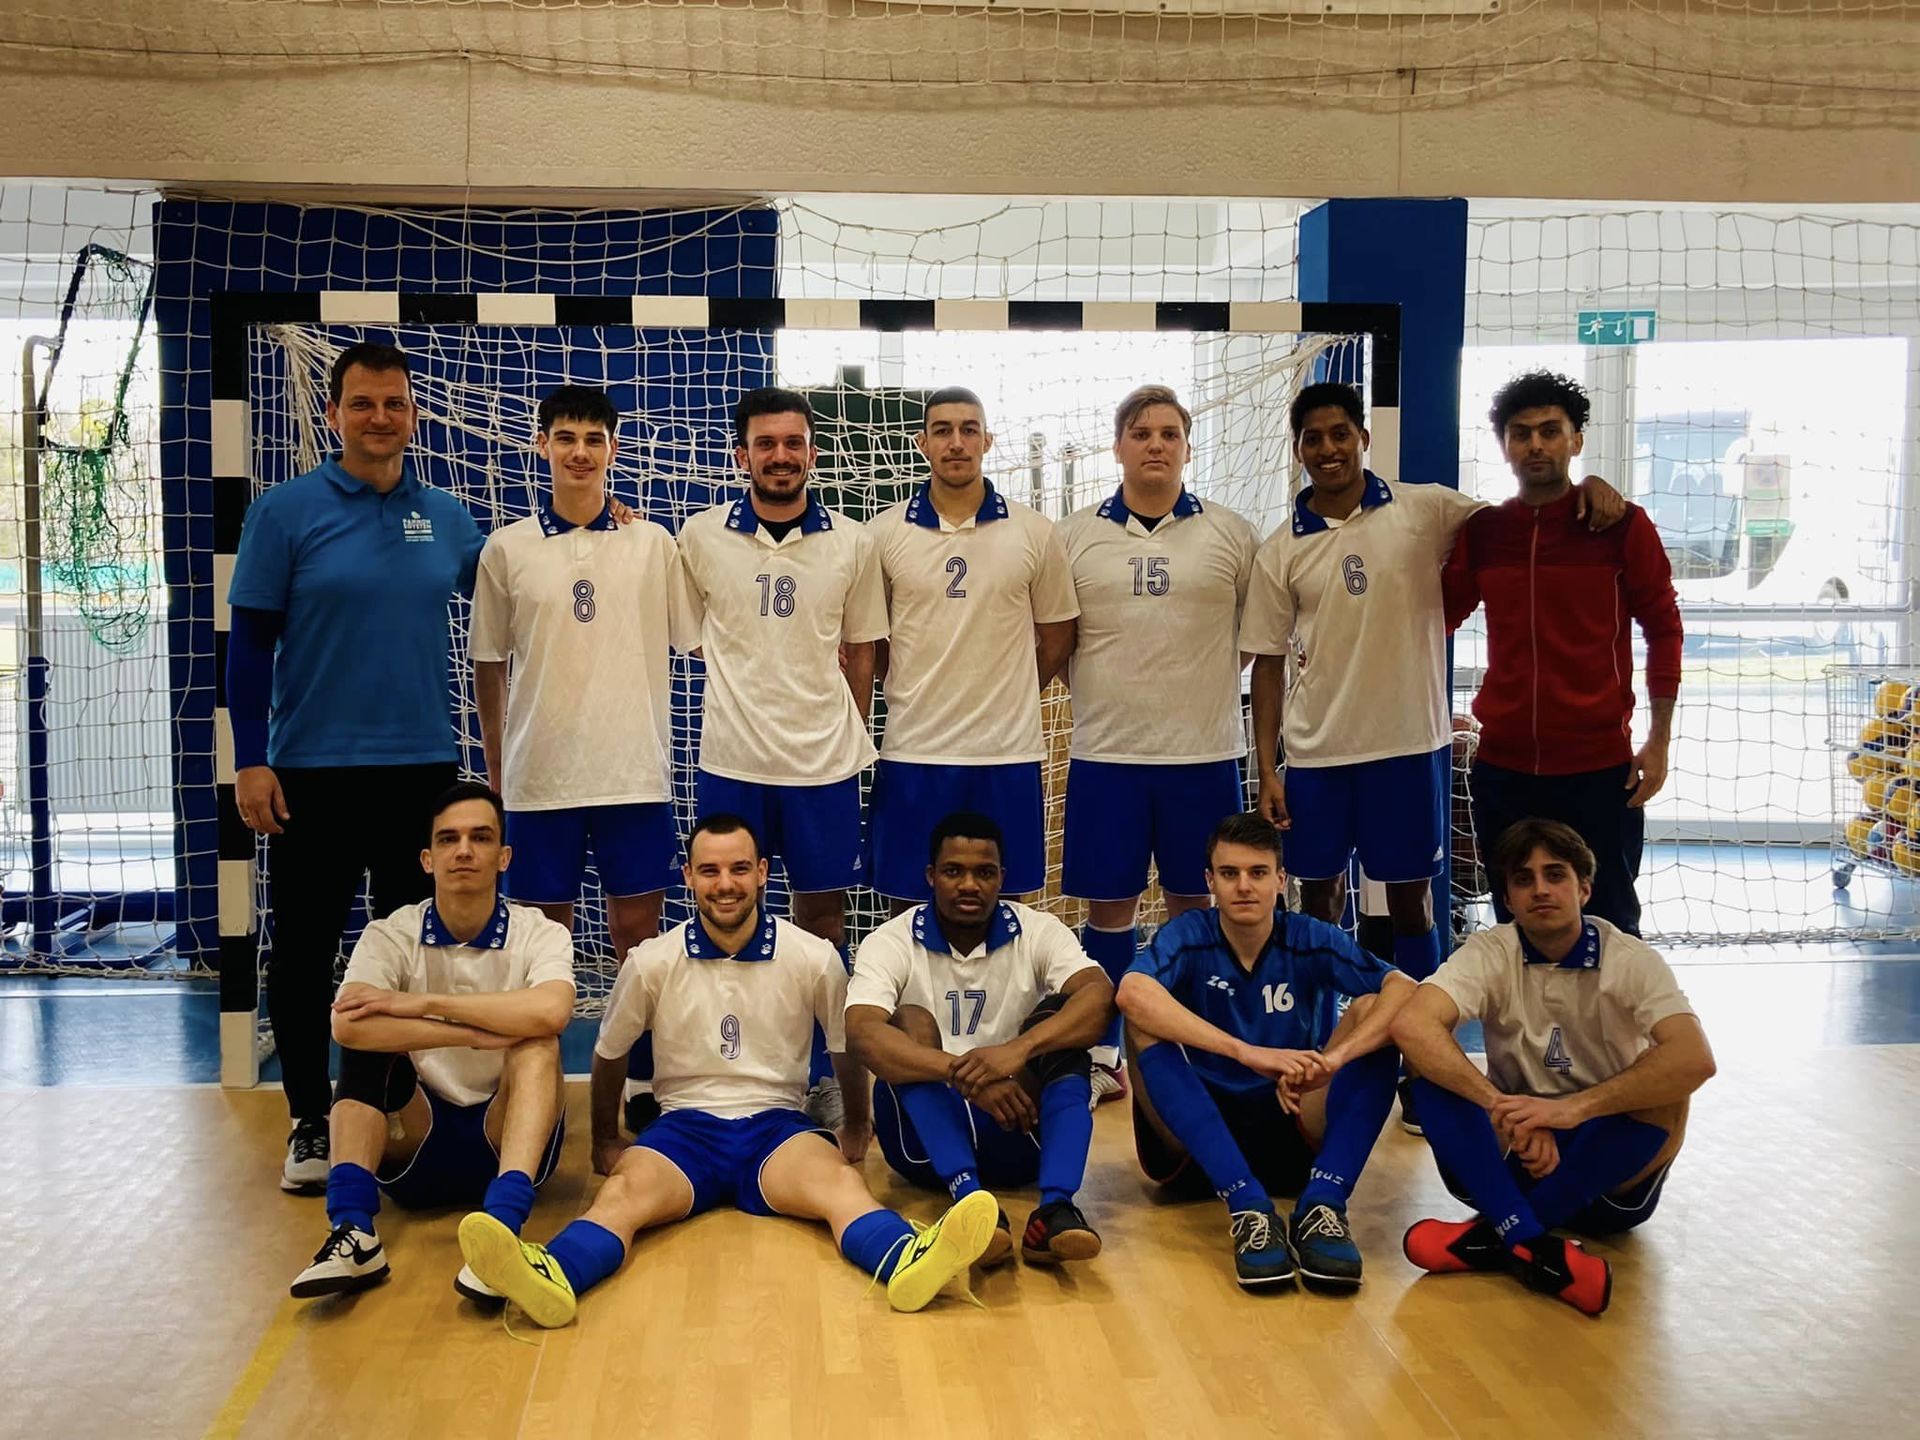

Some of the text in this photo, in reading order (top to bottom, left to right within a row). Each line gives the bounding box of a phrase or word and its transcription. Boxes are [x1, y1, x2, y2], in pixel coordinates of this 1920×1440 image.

[755, 574, 796, 617] 18
[945, 556, 968, 599] 2
[1128, 557, 1170, 596] 15
[1342, 554, 1367, 596] 6
[573, 579, 596, 623] 8
[946, 989, 987, 1036] 17
[1262, 982, 1294, 1014] 16
[720, 1014, 741, 1060] 9
[1543, 1027, 1573, 1076] 4
